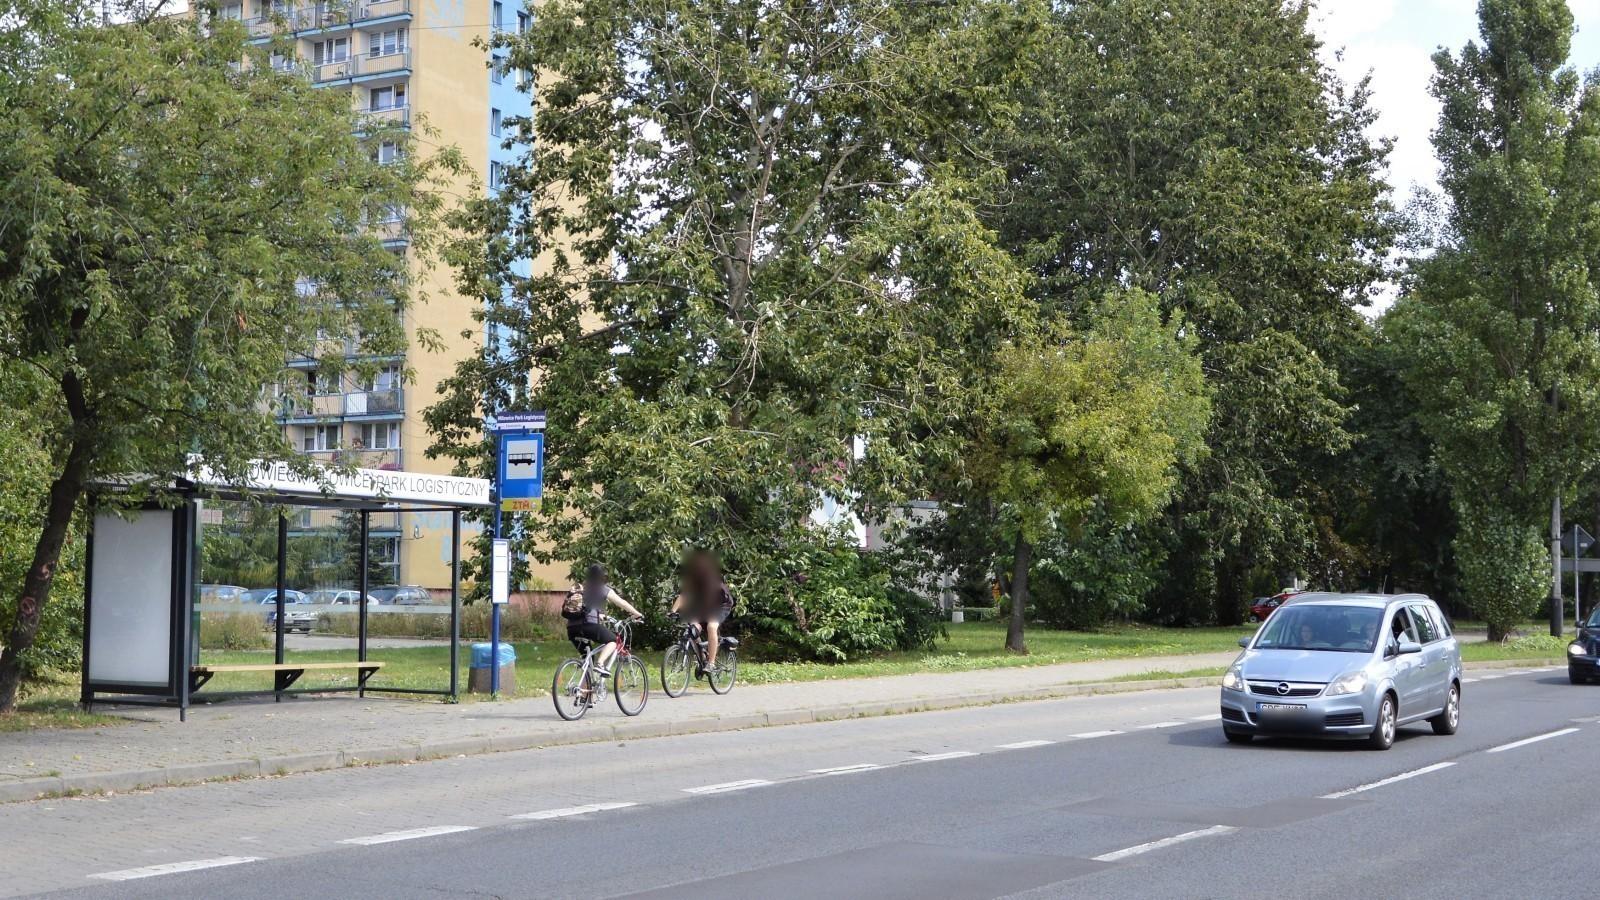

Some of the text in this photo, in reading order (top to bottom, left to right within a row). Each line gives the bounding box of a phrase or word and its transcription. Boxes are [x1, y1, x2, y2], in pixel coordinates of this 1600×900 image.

[376, 474, 407, 492] PARK
[410, 477, 486, 497] LOGISTYCZNY
[512, 500, 530, 510] ZTM
